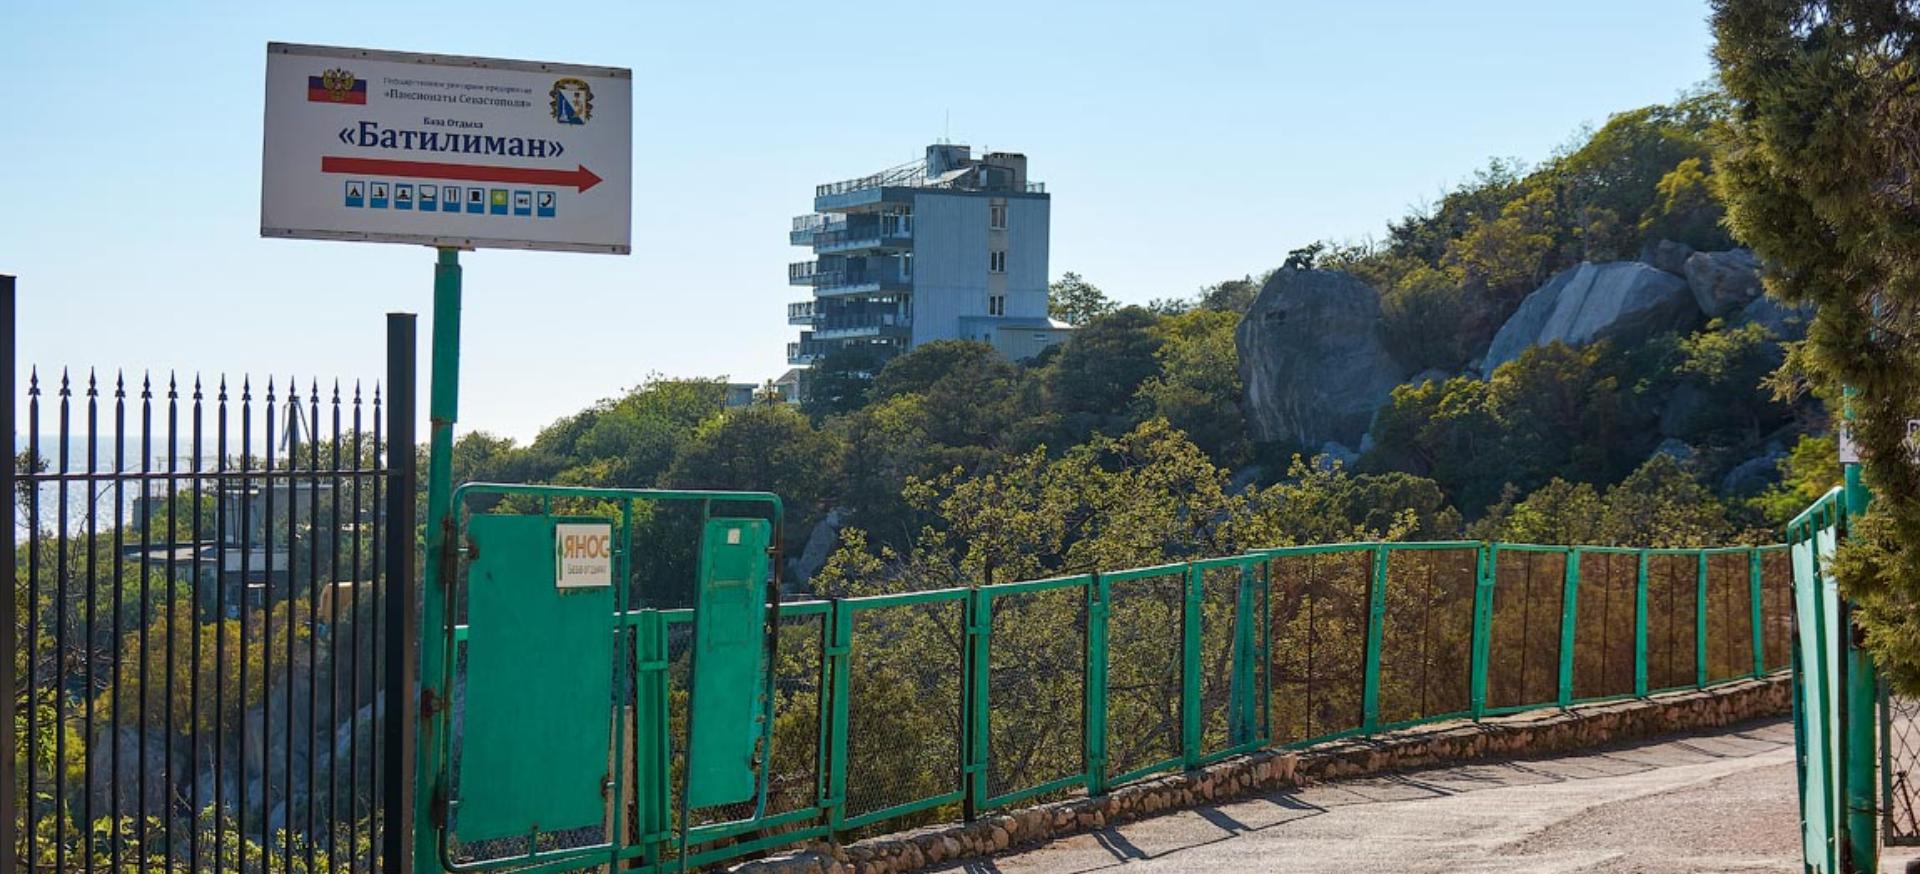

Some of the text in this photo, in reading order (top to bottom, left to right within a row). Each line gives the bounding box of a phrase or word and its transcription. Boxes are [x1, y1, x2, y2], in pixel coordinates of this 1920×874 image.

[423, 116, 484, 130] База Отдыха
[338, 120, 565, 158] «Батилиман»
